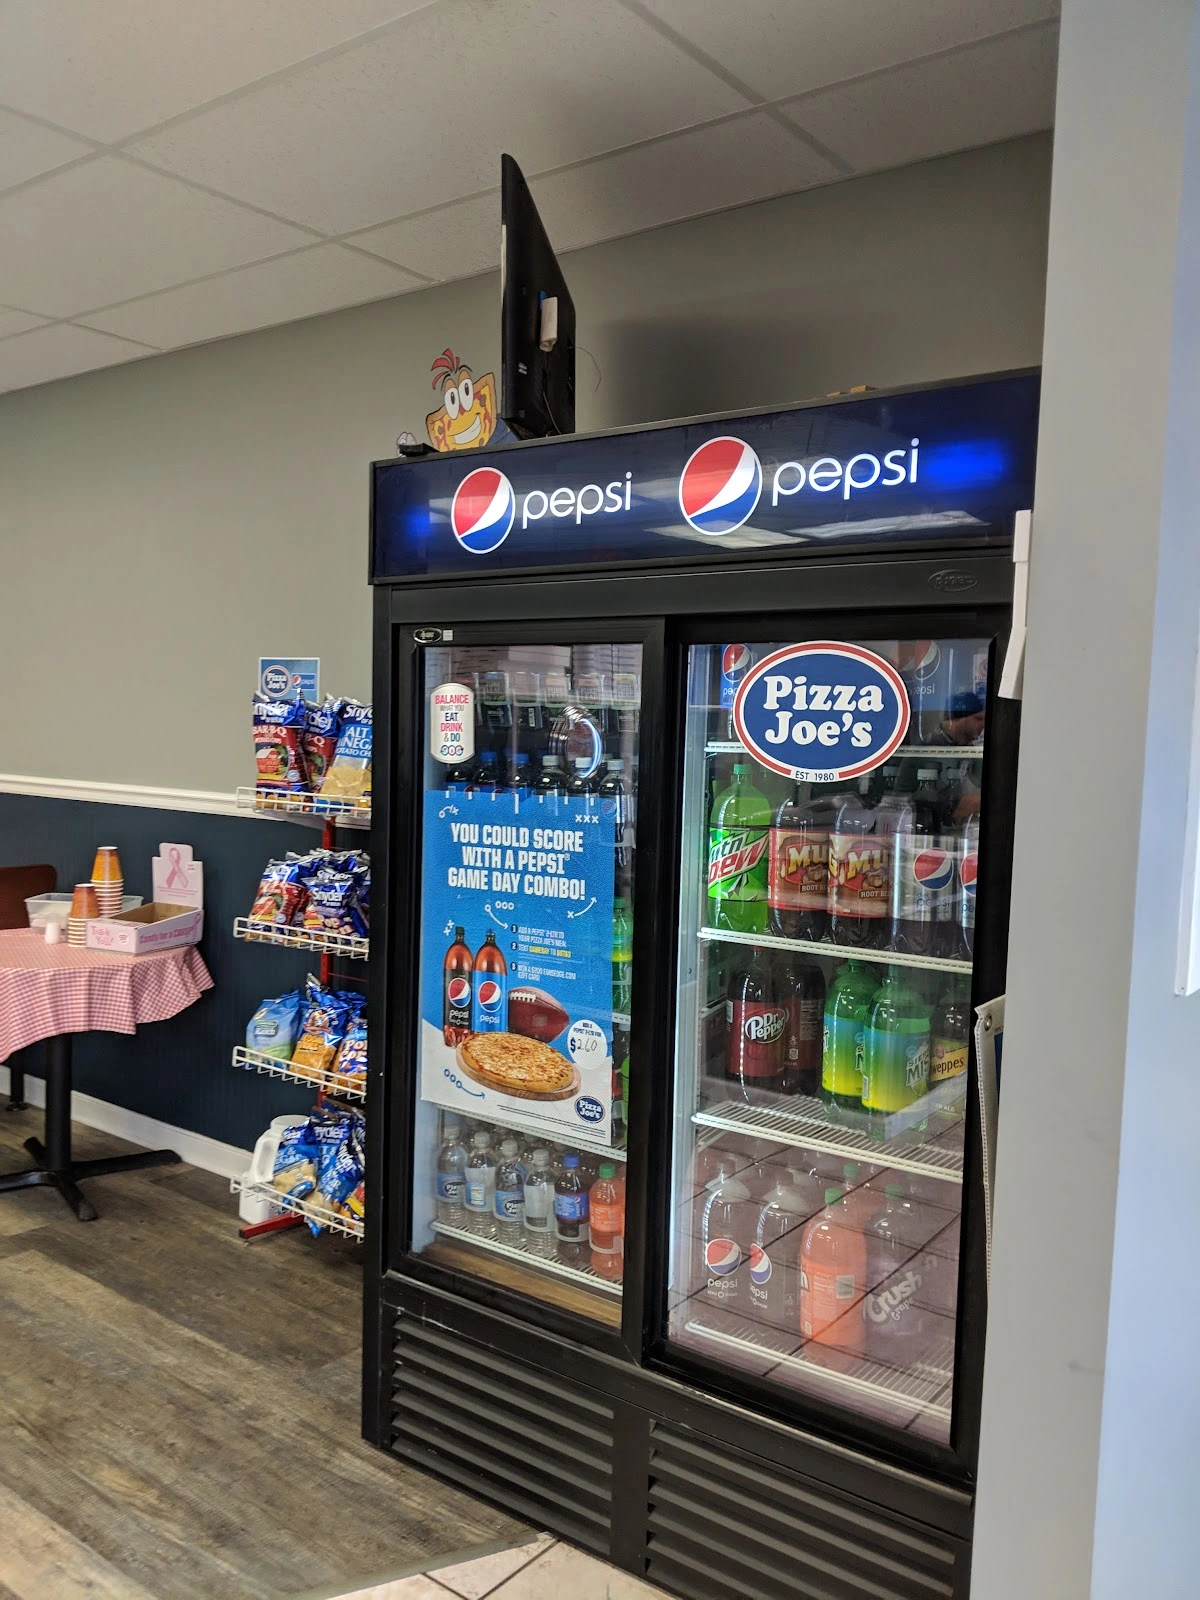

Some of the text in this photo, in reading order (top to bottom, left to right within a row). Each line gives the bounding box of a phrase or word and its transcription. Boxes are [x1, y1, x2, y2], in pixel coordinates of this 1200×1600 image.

[772, 437, 920, 507] pepsi
[522, 471, 632, 530] pepsi
[267, 673, 287, 682] Pizza
[435, 694, 469, 704] BALANCE
[763, 675, 884, 712] Pizza
[254, 701, 292, 721] nyder
[343, 704, 373, 721] Sny
[445, 712, 458, 721] EAT
[441, 722, 463, 732] DRINK
[764, 711, 873, 748] Joe's
[444, 733, 460, 742] & DO
[795, 771, 835, 782] EST 1980
[450, 823, 584, 852] YOU COULD SCORE
[462, 846, 501, 869] WITH
[505, 850, 515, 869] A
[788, 844, 829, 875] MU
[847, 849, 889, 880] MU
[448, 867, 586, 900] GAME DAY COMBO!
[801, 884, 819, 892] ROOT
[312, 888, 345, 904] Snyder
[861, 890, 879, 898] ROOT
[480, 1014, 500, 1024] pepsi
[763, 1013, 779, 1027] Dr
[745, 1016, 784, 1040] Pepper
[932, 1057, 965, 1075] weppes
[580, 1100, 602, 1112] Pizza
[580, 1108, 600, 1119] Joe's
[943, 1104, 956, 1112] ALE
[707, 1278, 738, 1290] pepsi
[750, 1283, 768, 1300] epsi
[866, 1271, 922, 1323] Crush
[891, 1297, 915, 1321] Grape
